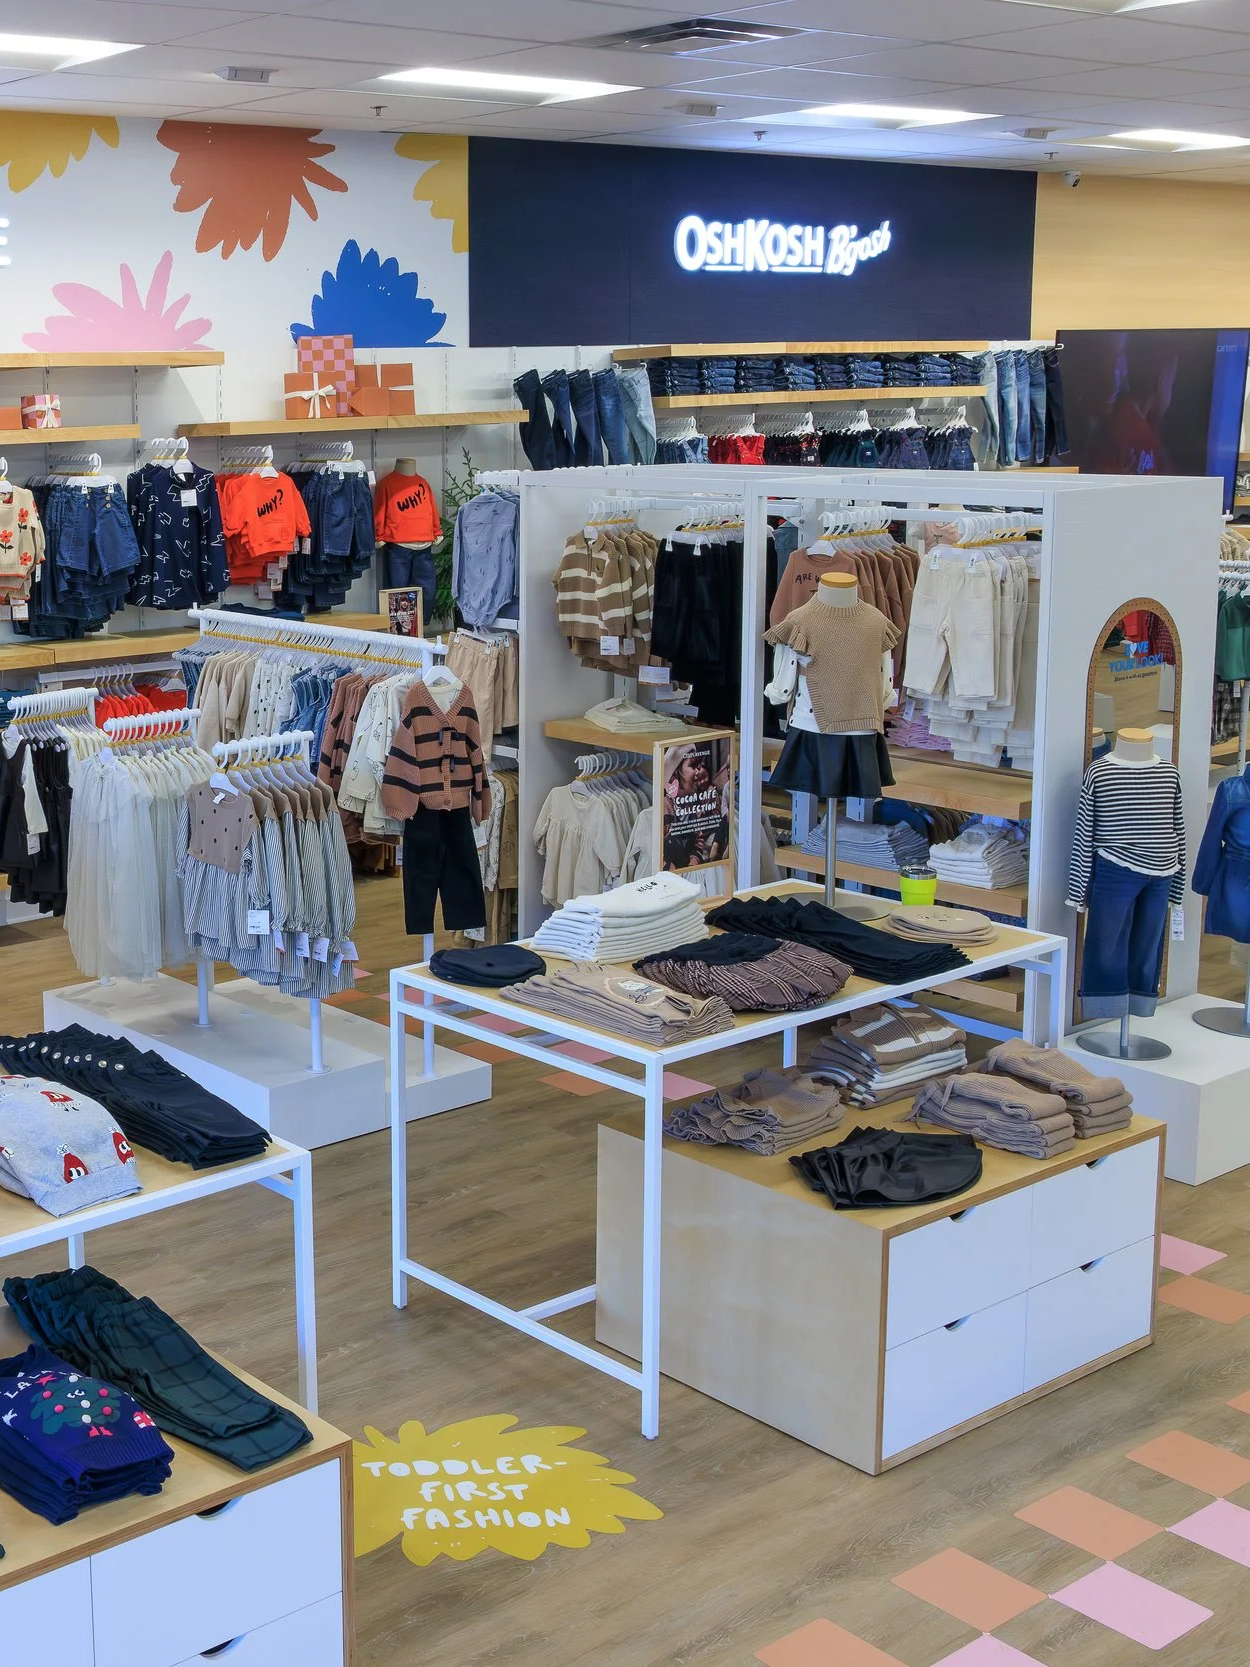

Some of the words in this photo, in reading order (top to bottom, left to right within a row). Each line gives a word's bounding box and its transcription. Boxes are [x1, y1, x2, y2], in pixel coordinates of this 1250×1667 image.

[674, 215, 825, 272] OSHKOSH
[257, 489, 284, 518] WHY?
[397, 483, 427, 512] WHY?
[795, 572, 812, 585] ARE
[1110, 657, 1135, 673] YOUR
[676, 793, 698, 805] COCOA
[699, 786, 717, 801] CAFÉ
[675, 801, 717, 817] COLLECTION
[3, 1381, 33, 1399] LA
[361, 1454, 568, 1478] TODDLER-
[419, 1481, 529, 1502] FIRST
[400, 1507, 572, 1530] FASHION
